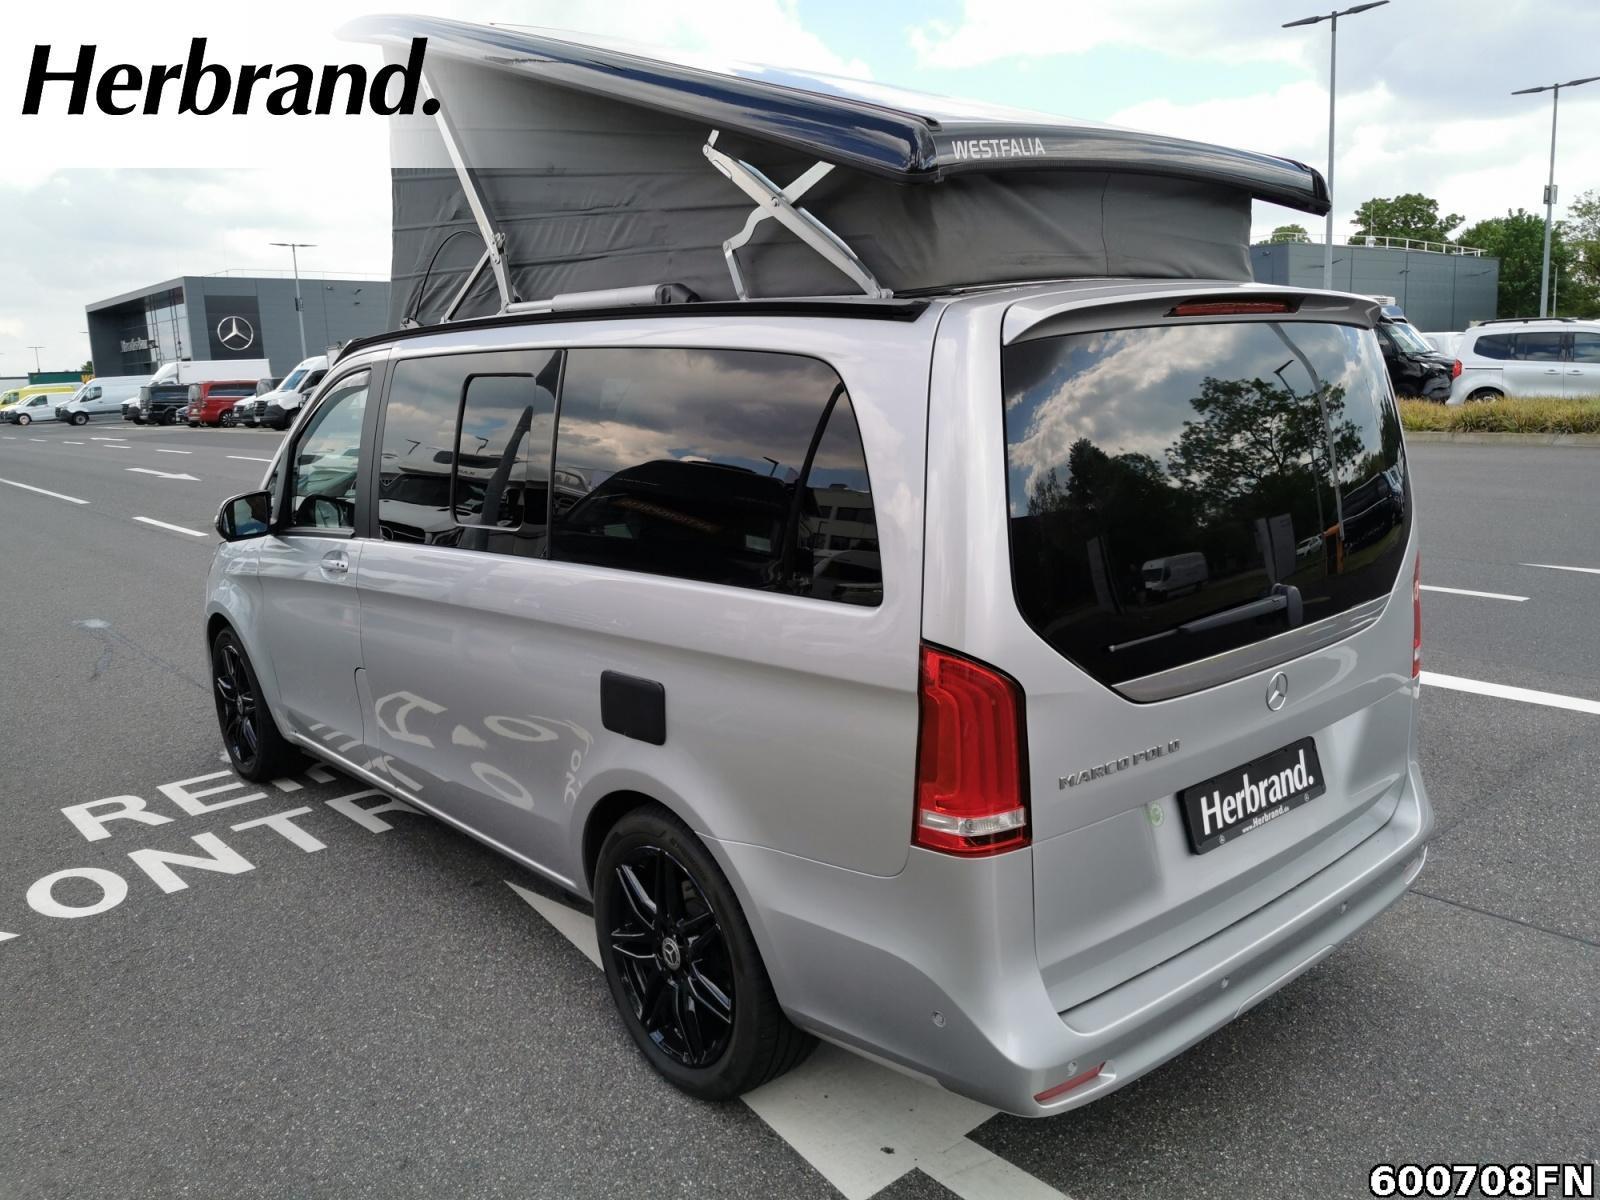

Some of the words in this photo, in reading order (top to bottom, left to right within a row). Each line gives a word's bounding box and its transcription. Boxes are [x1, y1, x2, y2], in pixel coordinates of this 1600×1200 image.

[951, 136, 1047, 160] WESTFALIA
[1059, 755, 1130, 790] MARCO
[1133, 738, 1181, 766] POLO
[1200, 748, 1315, 836] Herbrand.
[0, 786, 428, 943] ONTR
